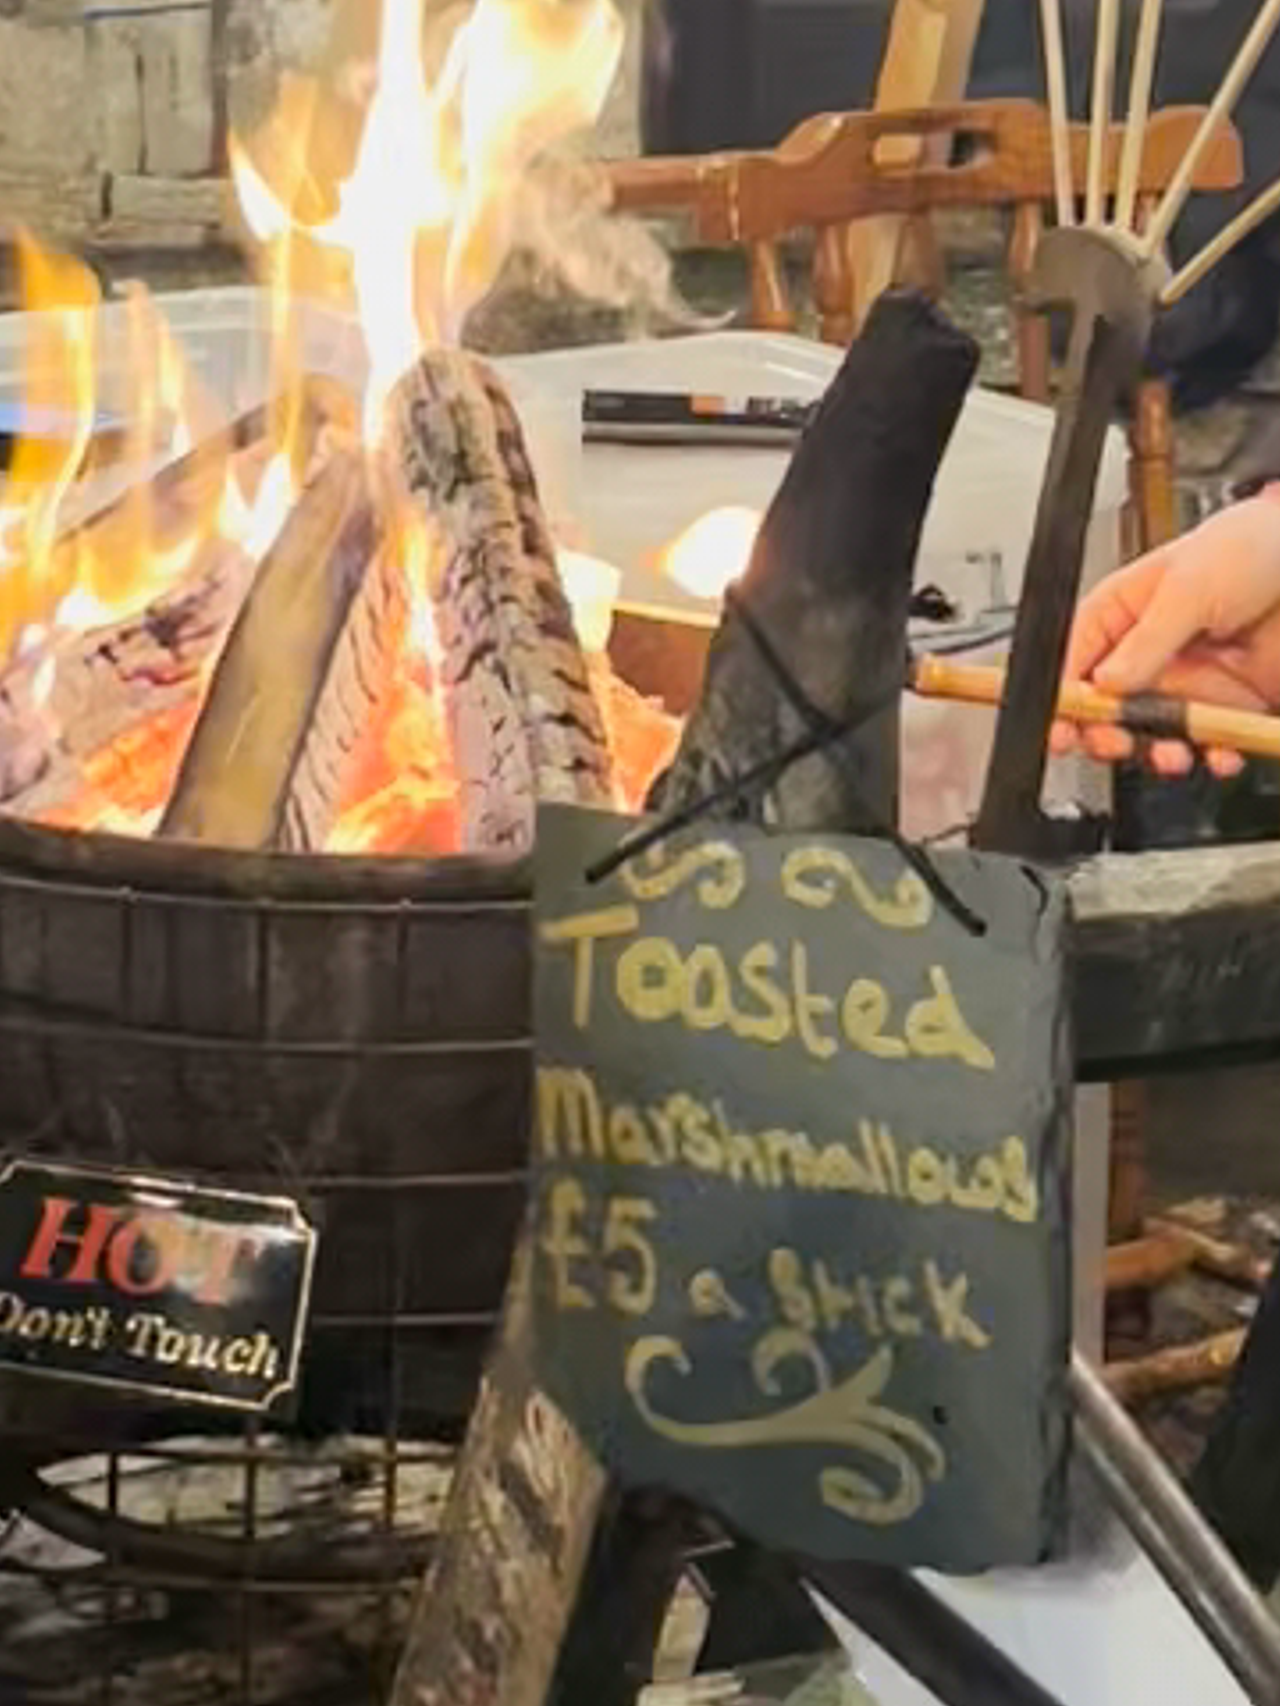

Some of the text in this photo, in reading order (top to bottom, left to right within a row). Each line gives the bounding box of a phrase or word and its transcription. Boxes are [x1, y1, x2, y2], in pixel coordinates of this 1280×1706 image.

[538, 902, 996, 1071] Toasted
[18, 1196, 266, 1308] HOT
[542, 1176, 657, 1316] £5
[688, 1268, 746, 1321] a
[125, 1312, 280, 1379] Touch
